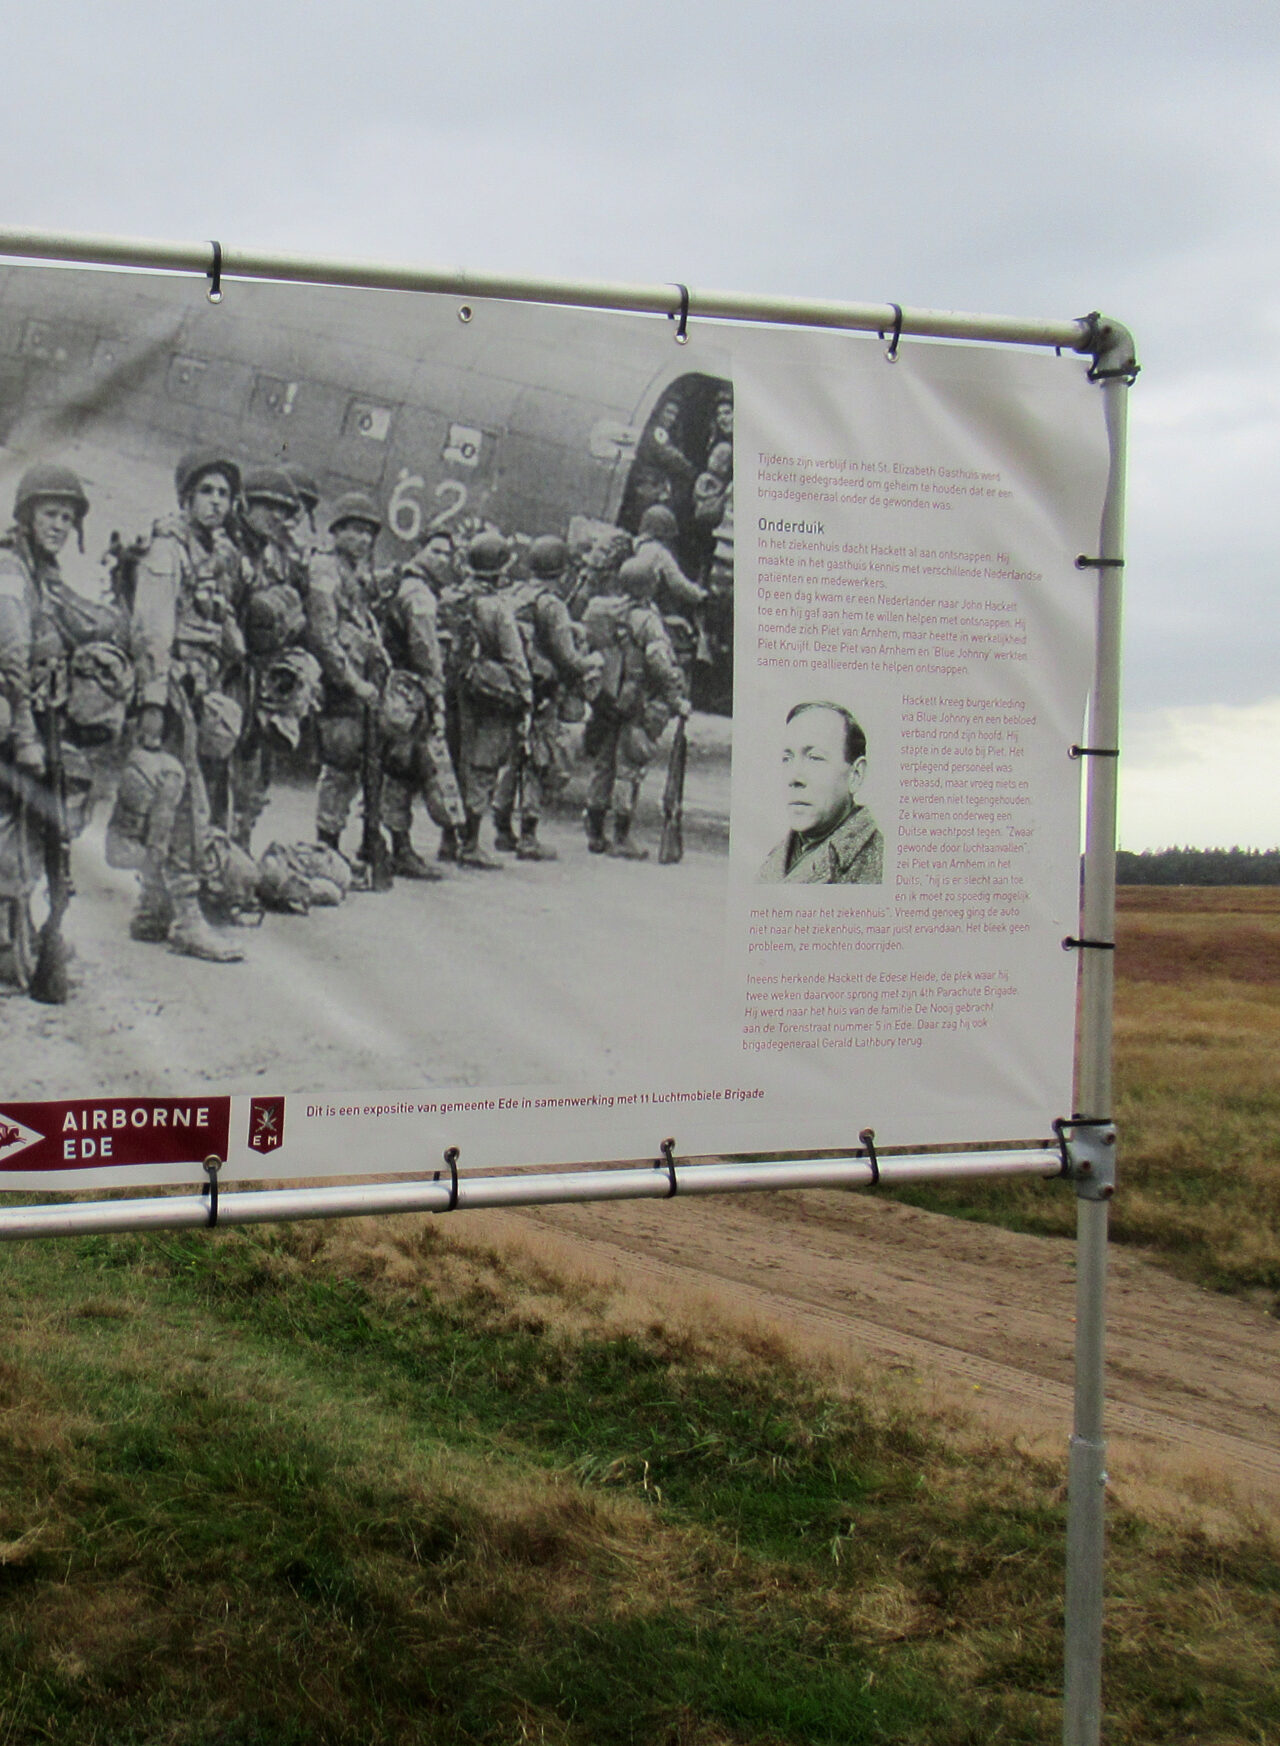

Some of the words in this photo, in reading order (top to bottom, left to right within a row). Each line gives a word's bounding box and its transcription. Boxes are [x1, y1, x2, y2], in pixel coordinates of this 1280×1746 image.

[758, 452, 794, 466] Tijdens
[796, 456, 812, 469] zijn
[815, 458, 846, 472] verblijf
[860, 460, 875, 472] het
[892, 463, 935, 477] Elizabeth
[938, 466, 978, 480] Gasthuis
[758, 469, 796, 483] Hackett
[799, 473, 864, 487] gedegradeerd
[884, 479, 918, 492] geheim
[932, 482, 966, 495] houden
[969, 484, 983, 496] dat
[758, 486, 837, 502] brigadegeneraal
[840, 492, 866, 504] onder
[883, 497, 929, 509] gewonden
[758, 518, 825, 535] Onderduik
[770, 538, 786, 550] het
[788, 540, 839, 553] ziekenhuis
[842, 542, 868, 555] dacht
[870, 544, 906, 557] Hackett
[920, 550, 936, 558] aan
[758, 555, 794, 567] maakte
[808, 557, 824, 569] het
[827, 559, 866, 572] gasthuis
[869, 561, 899, 573] kennis
[902, 563, 919, 574] met
[922, 564, 981, 577] verschillende
[774, 591, 791, 600] een
[794, 589, 812, 603] dag
[814, 590, 843, 602] kwam
[858, 596, 875, 604] een
[878, 594, 935, 608] Nederlander
[938, 600, 958, 609] naar
[758, 604, 772, 615] toe
[790, 606, 802, 620] hij
[804, 607, 819, 620] gaf
[822, 611, 839, 619] aan
[842, 609, 862, 620] hem
[876, 611, 903, 623] willen
[906, 612, 937, 626] helpen
[940, 614, 957, 625] met
[758, 622, 796, 634] noemde
[799, 624, 818, 635] zich
[821, 624, 839, 636] Piet
[842, 628, 858, 637] van
[902, 631, 926, 640] maar
[929, 629, 957, 641] heette
[758, 638, 777, 650] Piet
[813, 640, 837, 652] Deze
[840, 642, 858, 654] Piet
[860, 646, 876, 654] van
[879, 644, 915, 656] Arnhem
[758, 658, 790, 667] samen
[810, 658, 868, 671] geallieerden
[882, 660, 913, 674] helpen
[307, 1105, 322, 1117] Dit
[326, 1105, 336, 1116] is
[339, 1106, 360, 1116] een
[364, 1102, 414, 1117] expositie
[418, 1104, 436, 1113] van
[440, 1100, 494, 1114] gemeente
[498, 1098, 519, 1109] Ede
[522, 1097, 532, 1108] in
[534, 1094, 614, 1108] samenwerking
[617, 1094, 637, 1104] met
[640, 1094, 649, 1103] 11
[652, 1090, 722, 1103] Luchtmobiele
[724, 1088, 764, 1102] Brigade
[62, 1107, 209, 1132] AIRBORNE
[63, 1136, 113, 1160] EDE
